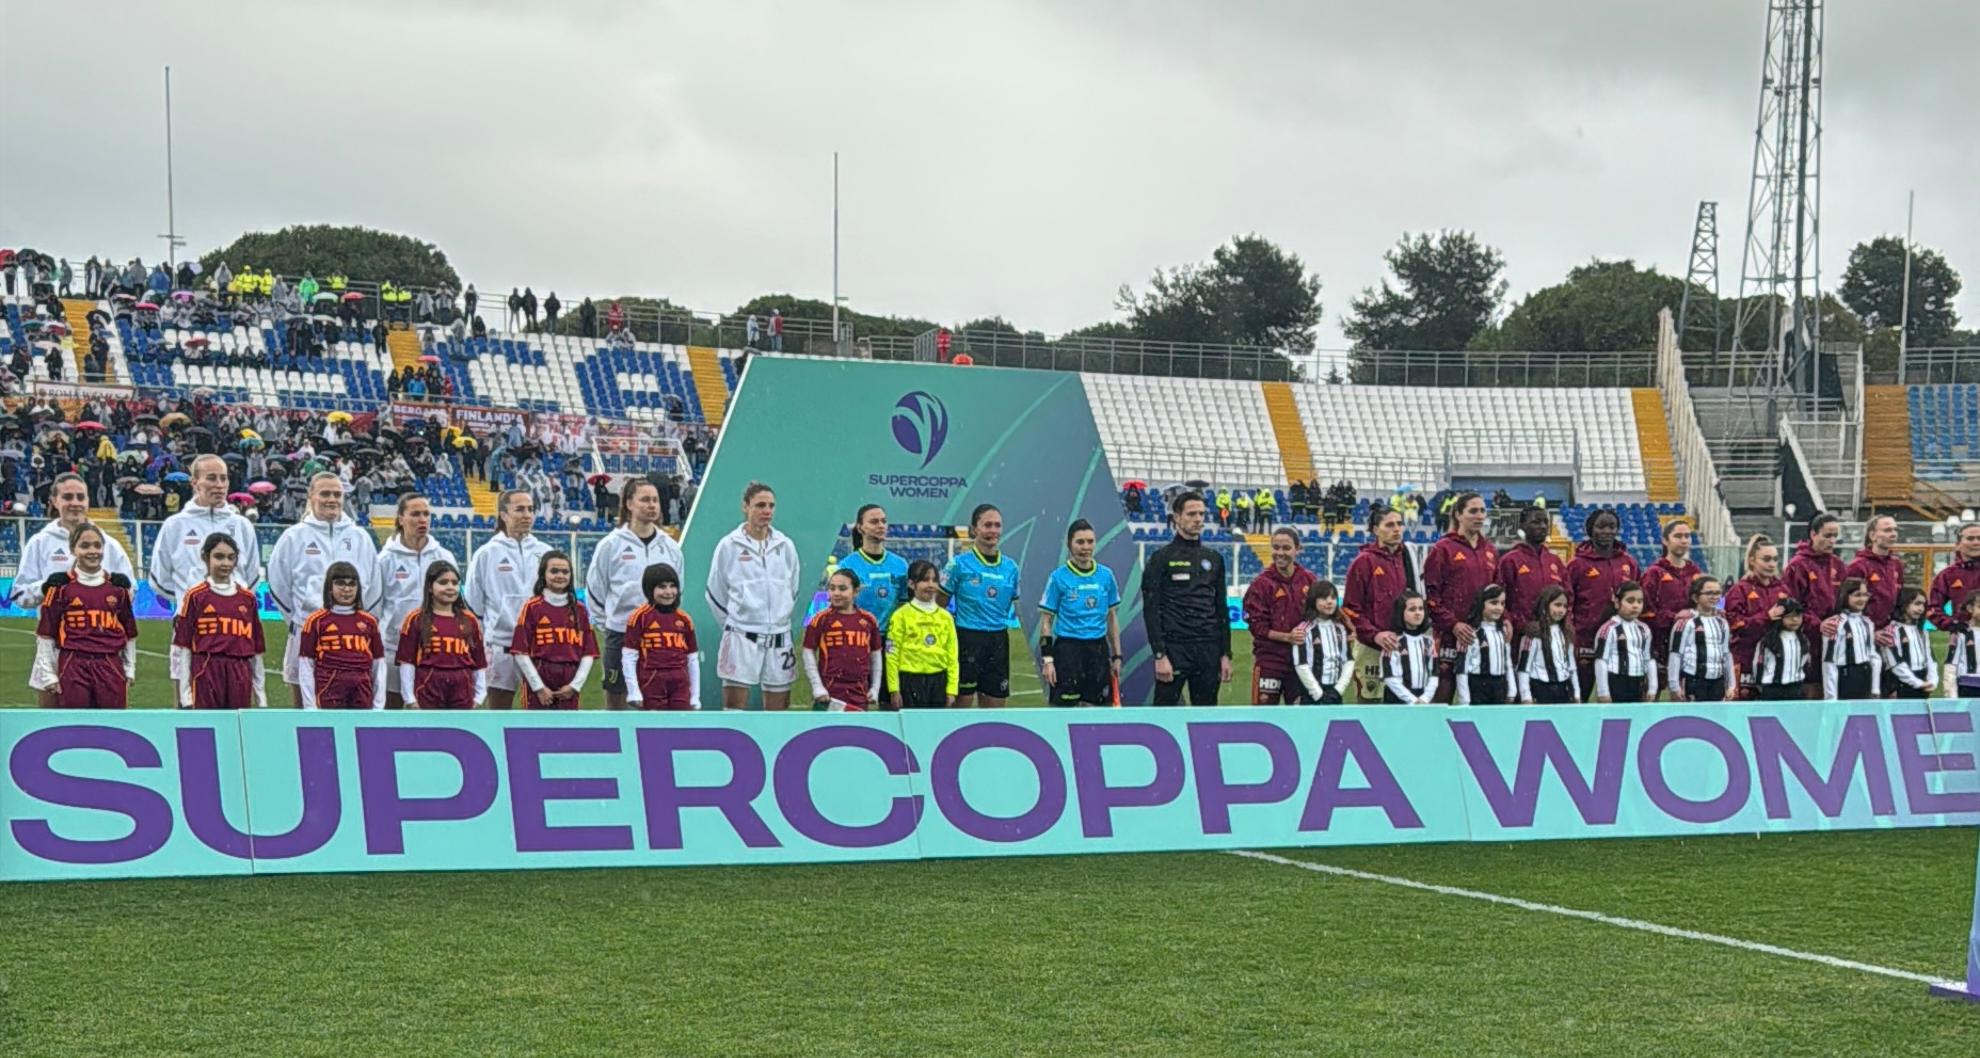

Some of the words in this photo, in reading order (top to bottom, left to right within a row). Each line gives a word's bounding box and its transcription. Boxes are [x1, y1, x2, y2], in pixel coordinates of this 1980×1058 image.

[456, 409, 524, 425] FINLANDIA
[868, 473, 968, 488] SUPERCOPPA
[889, 486, 949, 498] WOMEN
[87, 609, 118, 628] TIM
[218, 616, 252, 639] TIM
[9, 720, 1421, 865] SUPERCOPPA
